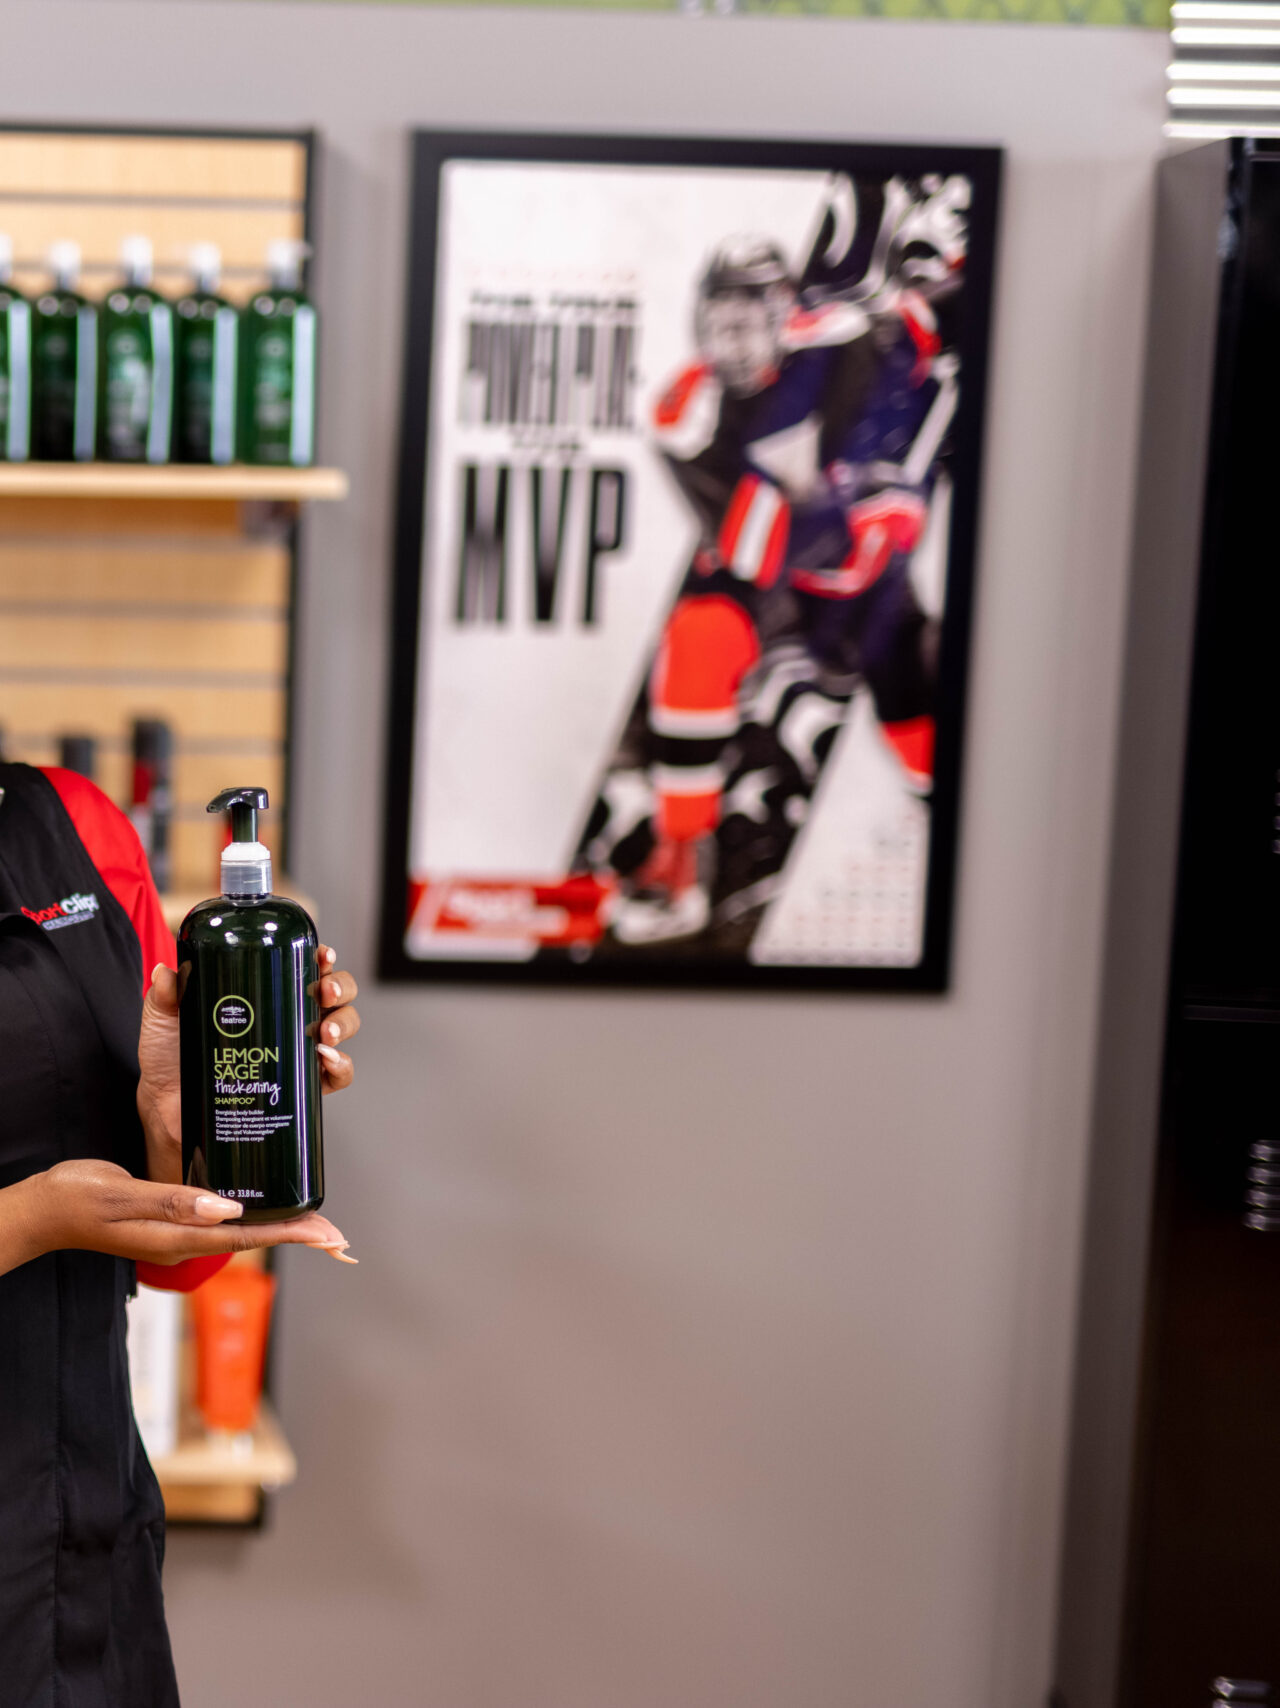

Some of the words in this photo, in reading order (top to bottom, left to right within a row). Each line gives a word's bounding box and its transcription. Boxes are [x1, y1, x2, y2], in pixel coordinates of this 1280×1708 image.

[457, 462, 628, 625] MVP
[214, 1046, 279, 1064] LEMON
[214, 1063, 259, 1080] SAGE
[214, 1079, 282, 1106] thickening
